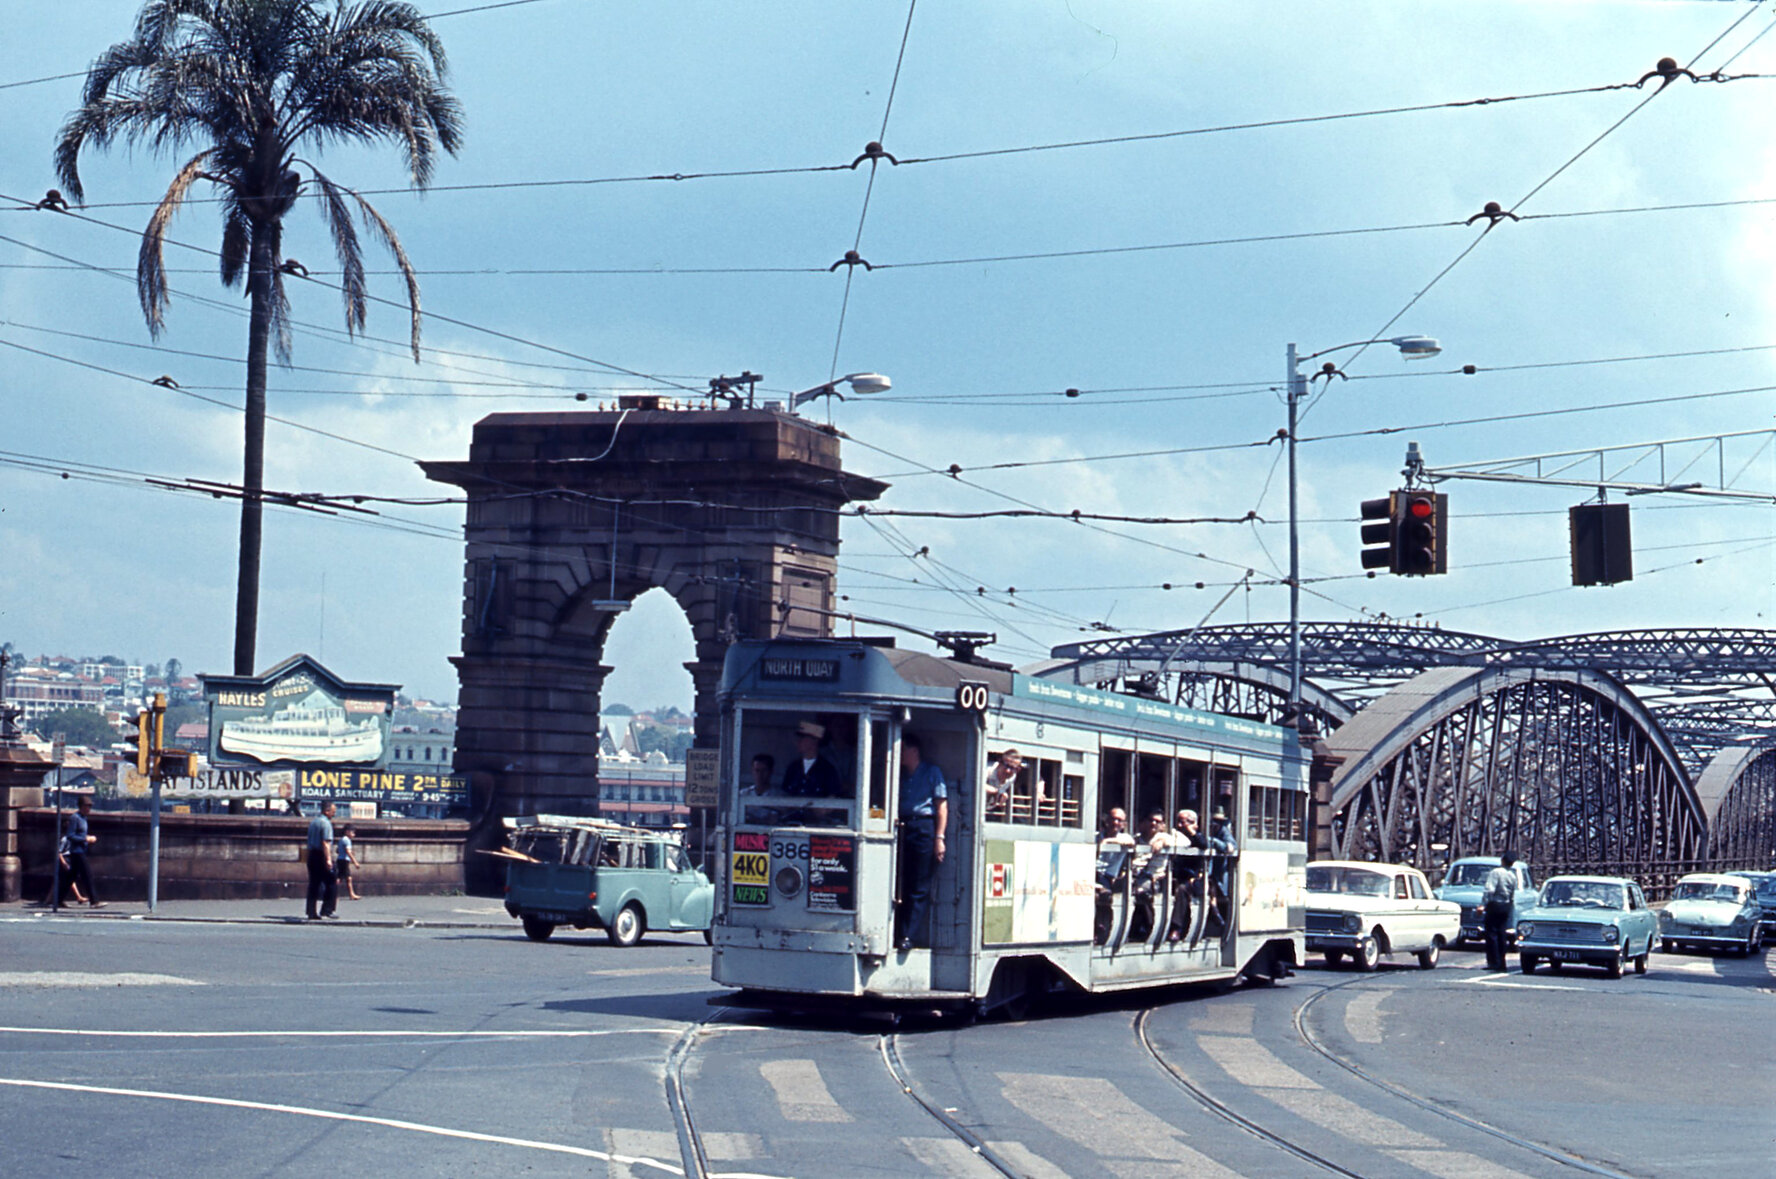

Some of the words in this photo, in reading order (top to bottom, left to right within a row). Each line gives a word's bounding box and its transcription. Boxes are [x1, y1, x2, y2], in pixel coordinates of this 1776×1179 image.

[764, 660, 802, 676] NORTH
[806, 661, 834, 677] QUAY
[218, 691, 267, 708] HAYLES
[961, 685, 987, 710] 00
[693, 763, 715, 771] LOAD
[189, 770, 262, 790] ISLANDS
[301, 769, 353, 789] LONE
[359, 773, 406, 791] PINE
[441, 777, 467, 789] DAILY
[694, 773, 714, 781] LIMIT
[301, 787, 332, 798] KOALA
[335, 788, 386, 799] SANCTUARY
[734, 833, 769, 851] MUSIC
[772, 842, 810, 860] 386
[733, 854, 768, 877] 4KQ
[734, 885, 768, 903] NEWS
